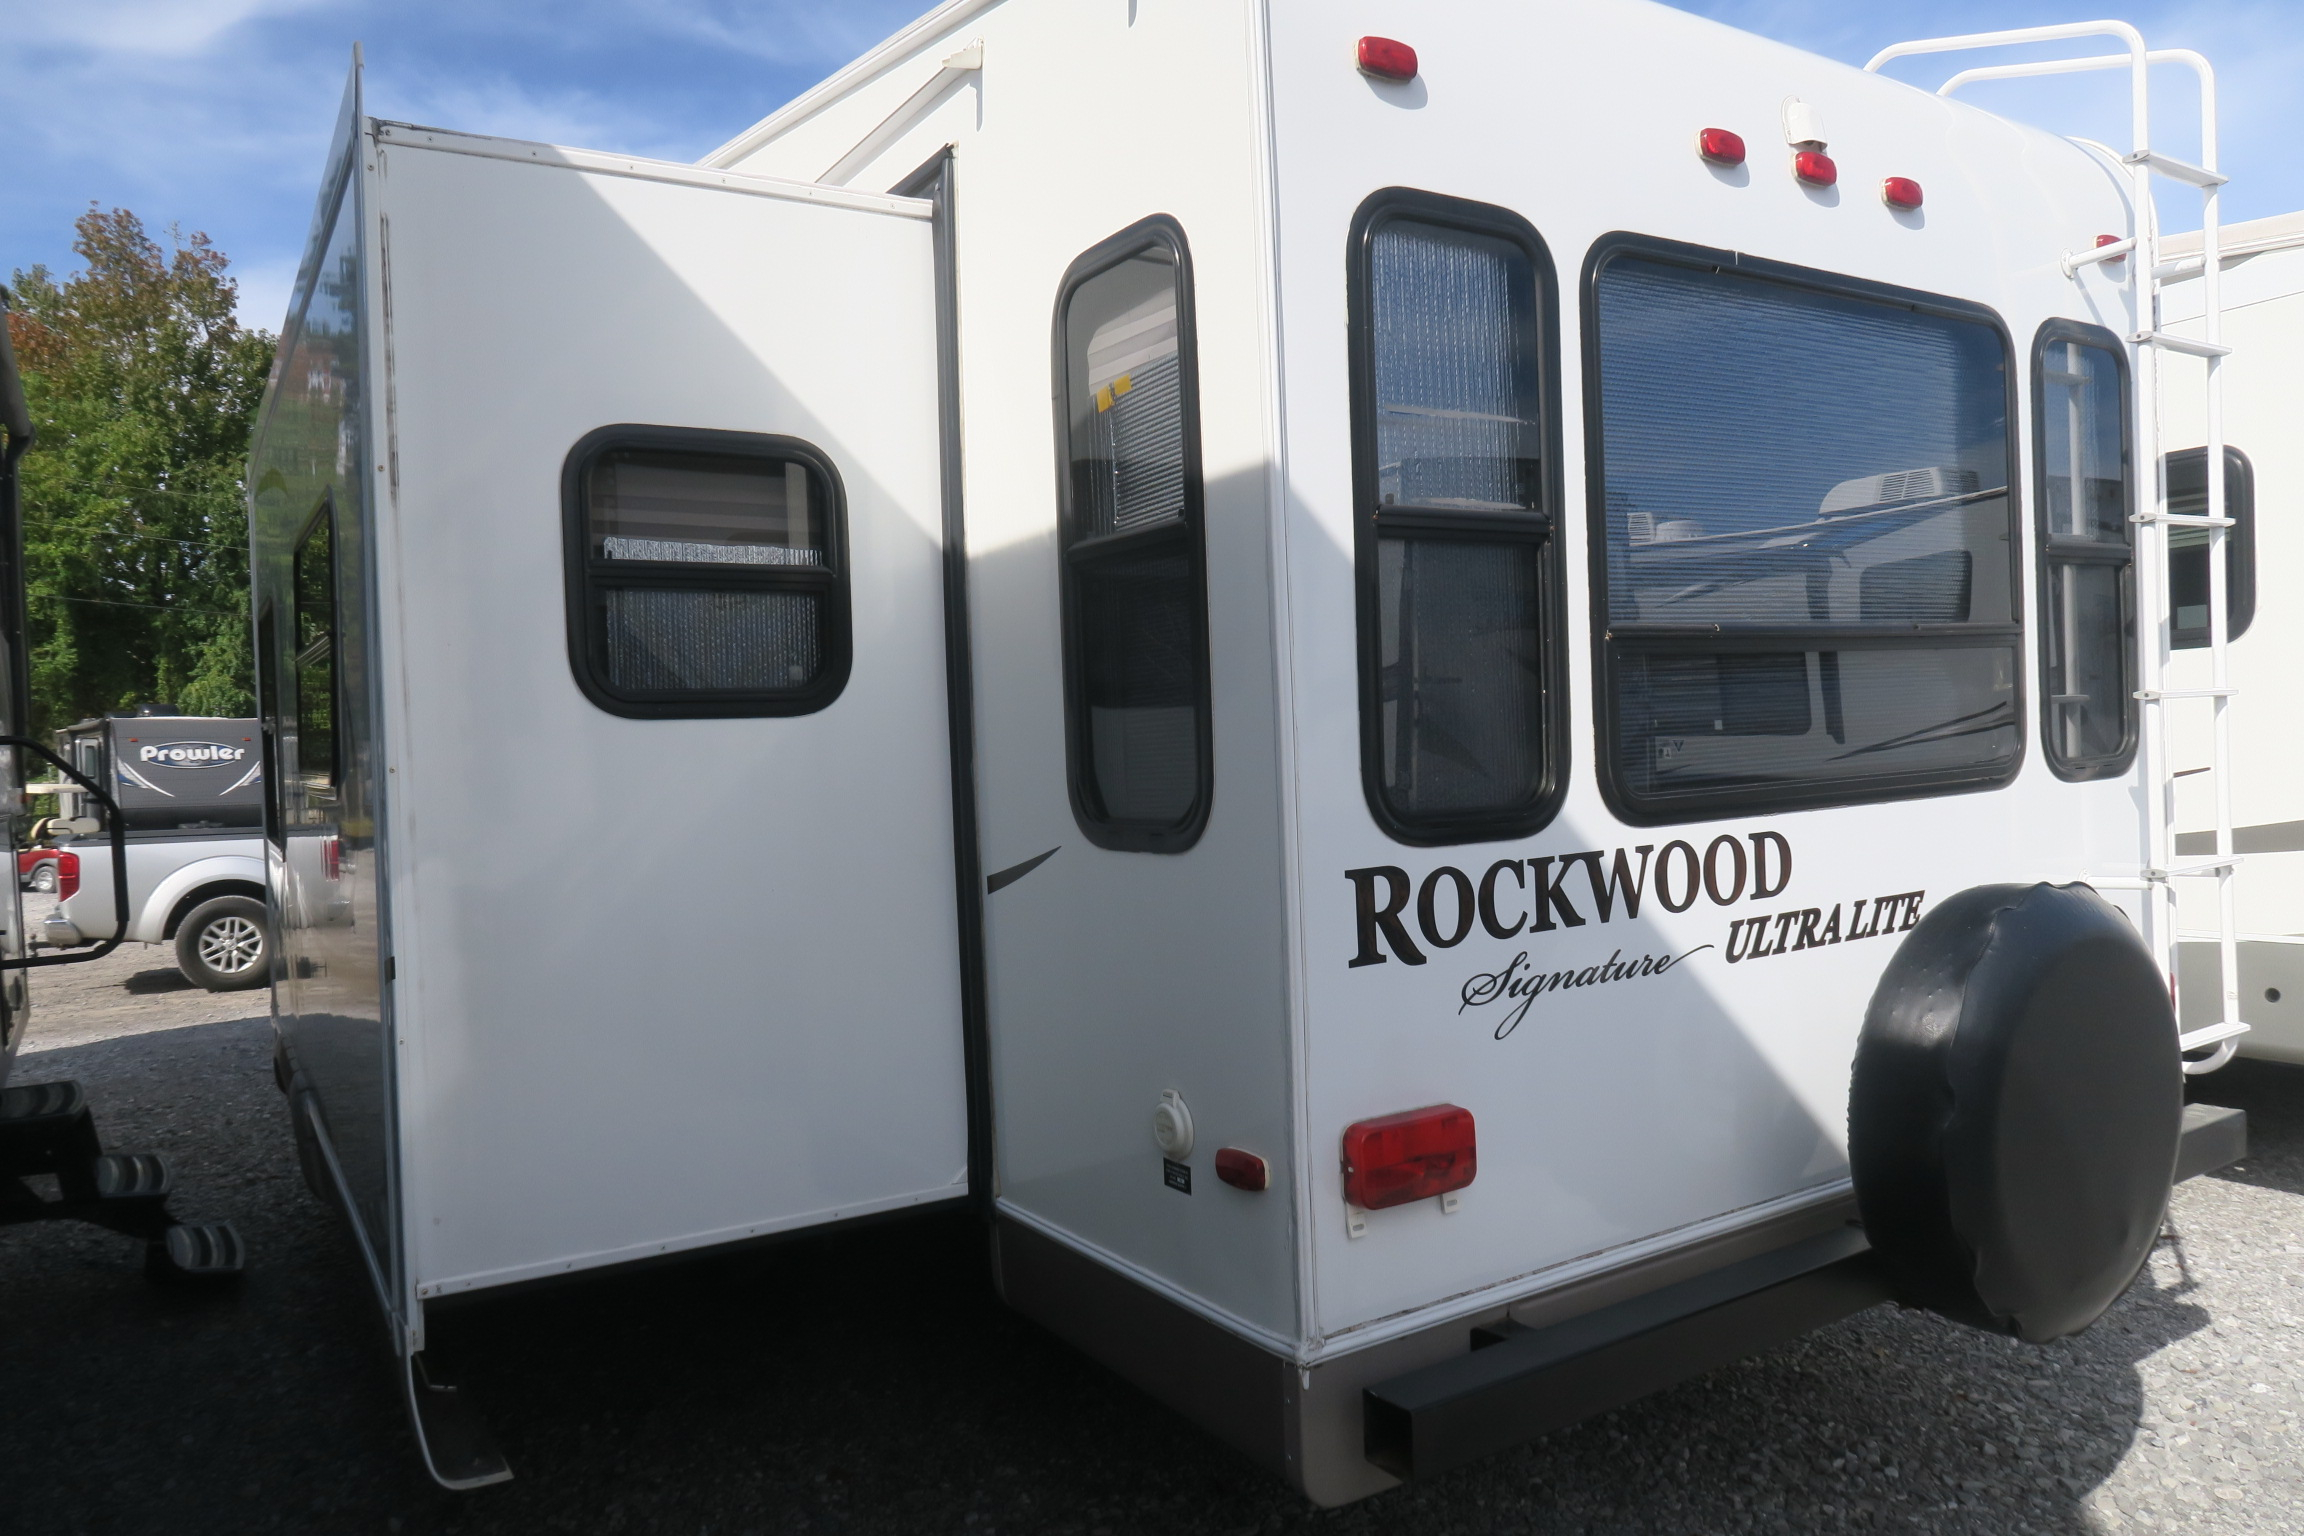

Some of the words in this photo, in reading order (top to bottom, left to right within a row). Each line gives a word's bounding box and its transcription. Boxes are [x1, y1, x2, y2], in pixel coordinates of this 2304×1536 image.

[140, 746, 245, 762] Prowler
[1345, 831, 1792, 968] ROCKWOOD
[1458, 944, 1715, 1041] Signature
